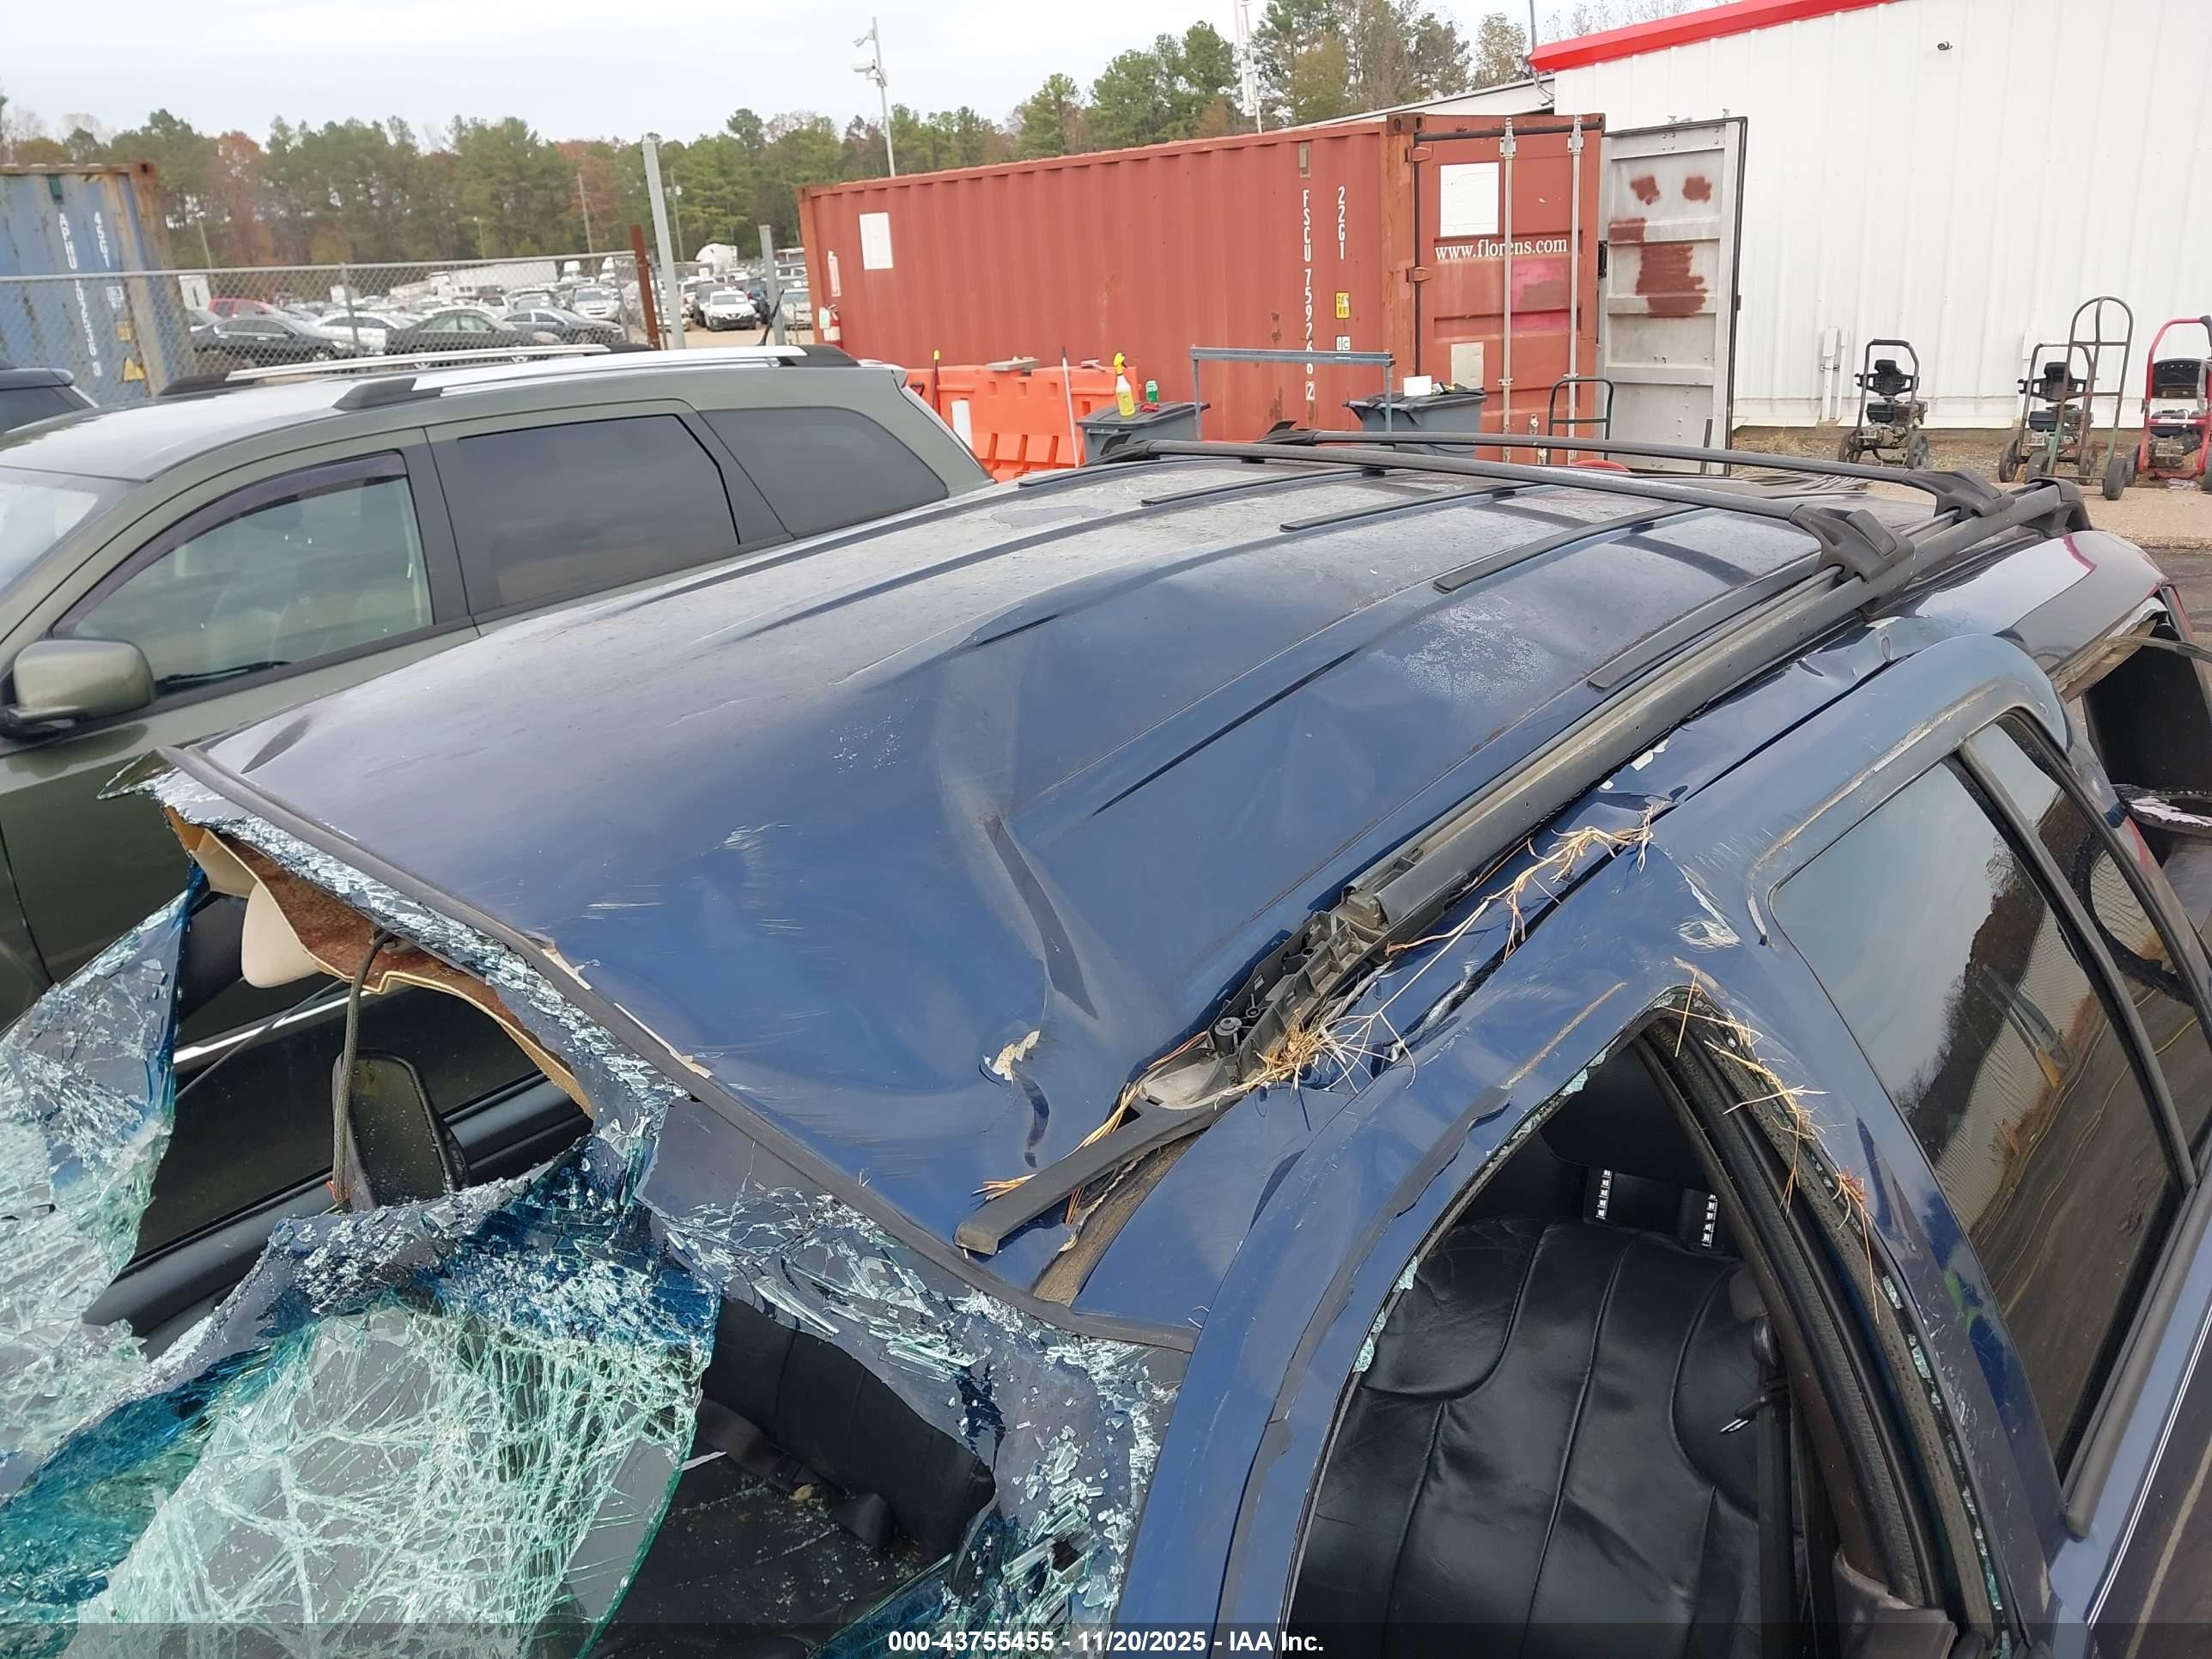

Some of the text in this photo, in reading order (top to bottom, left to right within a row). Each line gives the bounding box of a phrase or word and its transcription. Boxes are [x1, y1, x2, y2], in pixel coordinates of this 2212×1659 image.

[94, 211, 111, 269] 45G1
[1303, 189, 1312, 263] FSCU
[1338, 185, 1346, 261] 22G1
